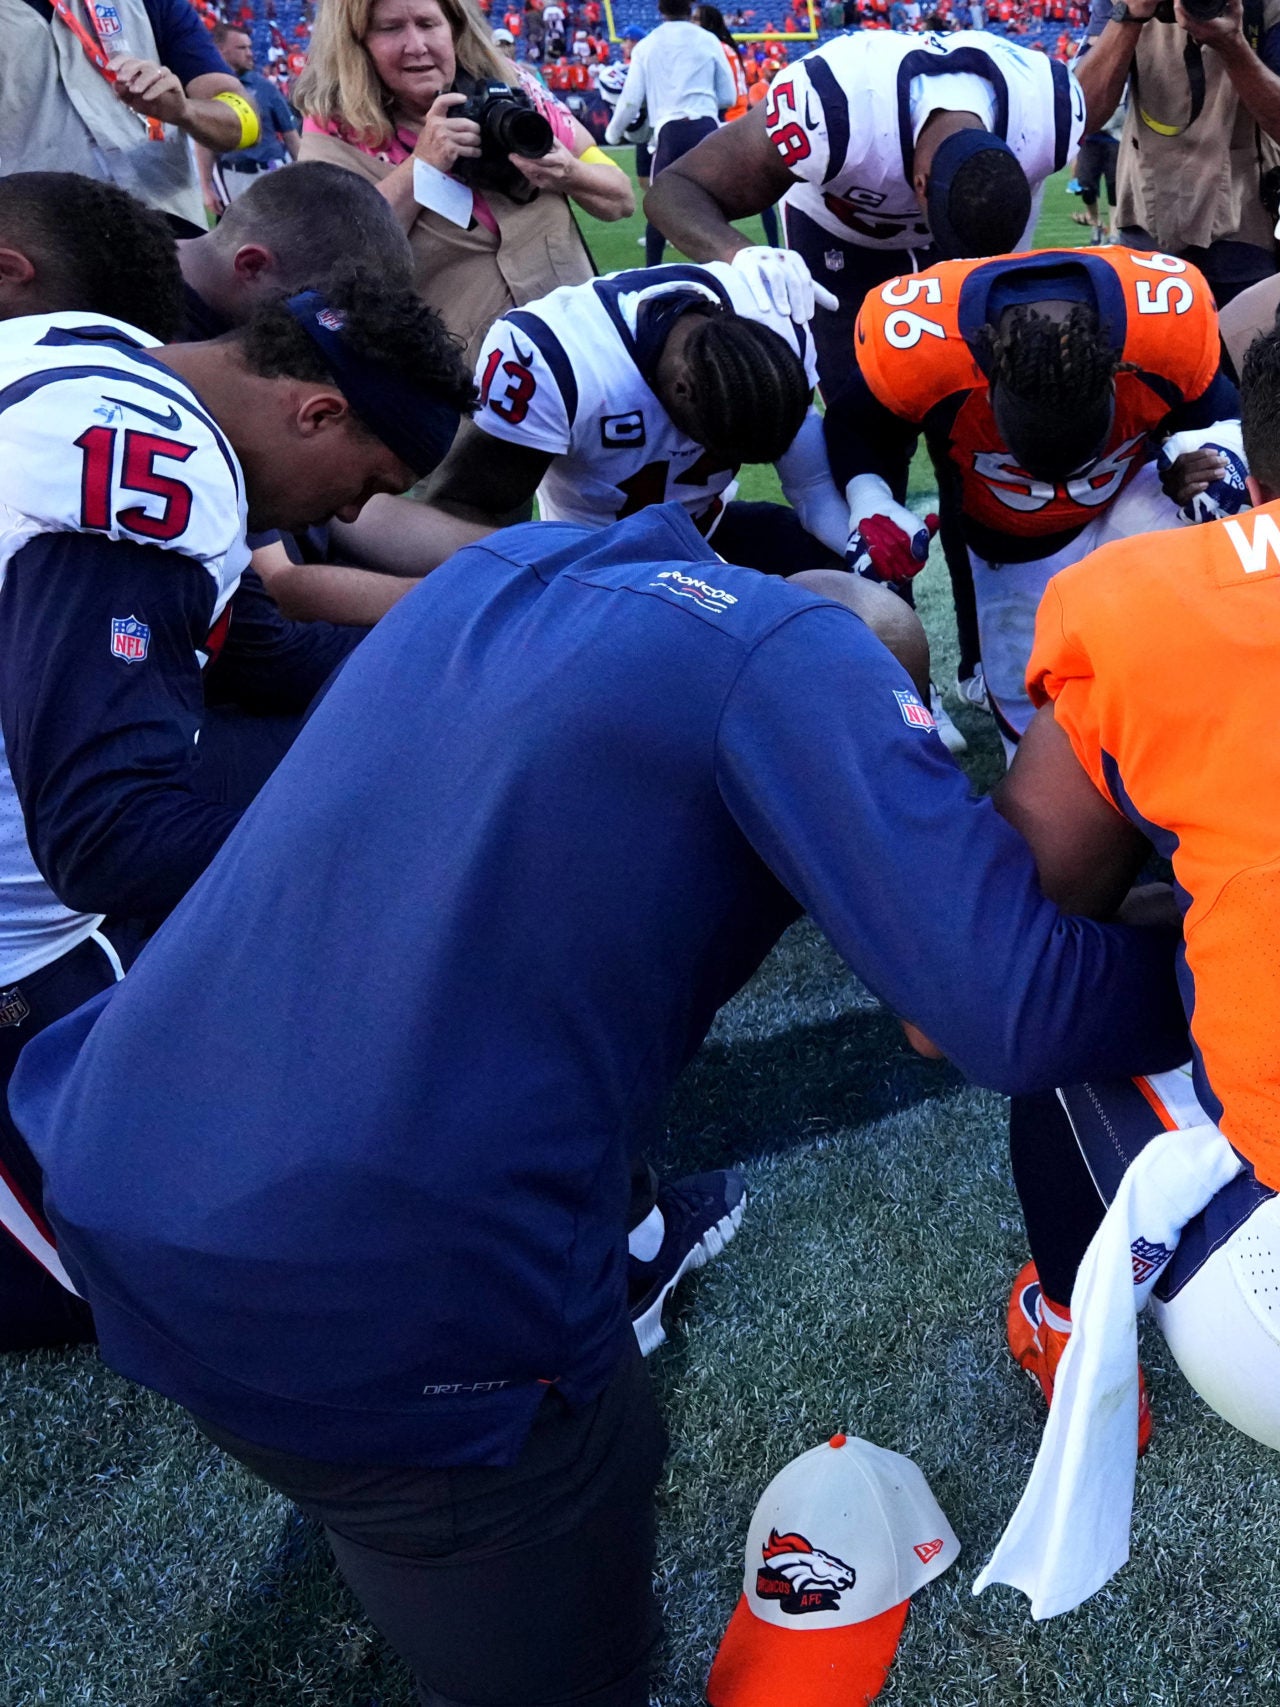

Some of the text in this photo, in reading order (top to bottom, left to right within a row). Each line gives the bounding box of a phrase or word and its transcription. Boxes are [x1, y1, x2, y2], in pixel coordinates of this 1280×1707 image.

[766, 80, 812, 168] 58
[1130, 252, 1194, 316] 56
[880, 276, 947, 350] 56
[480, 347, 537, 425] 13
[72, 424, 198, 542] 15
[657, 570, 739, 605] BRONCOS
[114, 634, 145, 658] NFL
[904, 704, 937, 726] NFL
[422, 1380, 511, 1395] DRI-FIT
[757, 1575, 791, 1595] BRONCOS
[800, 1592, 823, 1608] AFC
